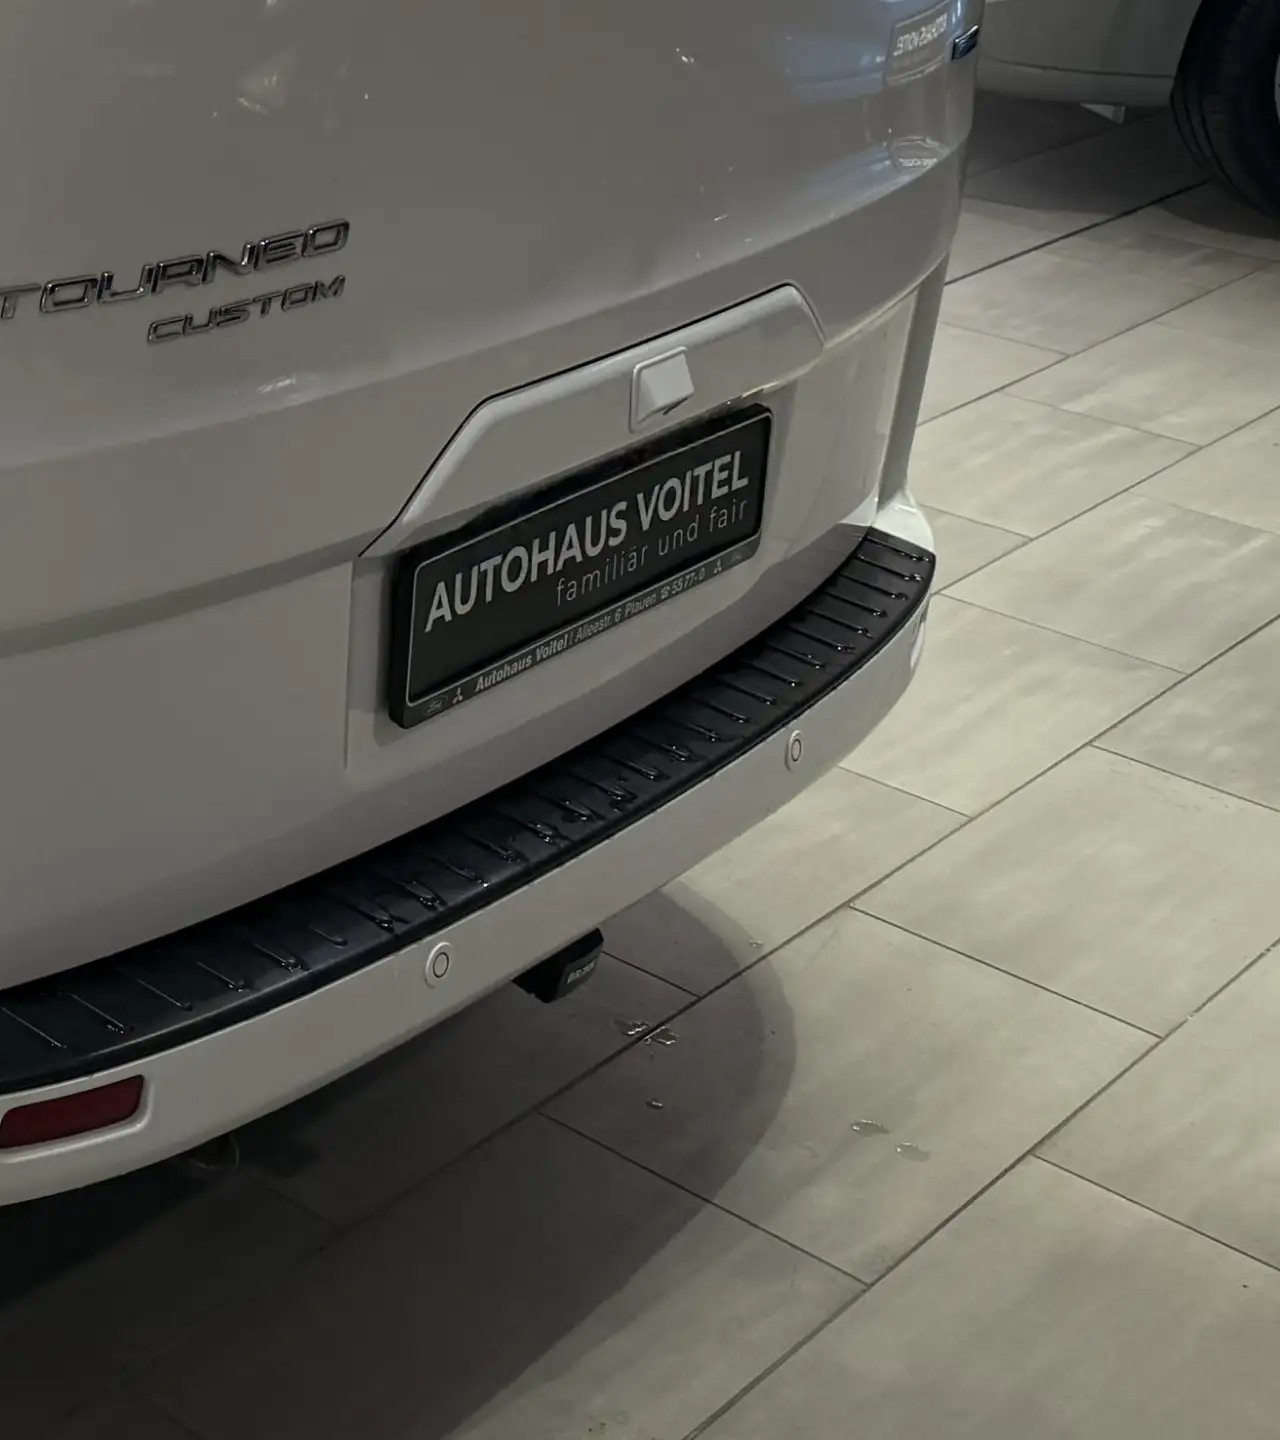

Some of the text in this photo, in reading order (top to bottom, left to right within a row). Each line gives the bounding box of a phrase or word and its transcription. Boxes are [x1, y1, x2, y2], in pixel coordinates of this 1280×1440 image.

[146, 274, 347, 344] CUSTOM
[424, 450, 750, 633] AUTOHAUS VOITEL
[556, 498, 748, 607] familiär und fair
[474, 654, 533, 693] Autohaus
[535, 634, 568, 662] Voitel
[624, 593, 656, 618] Plauen
